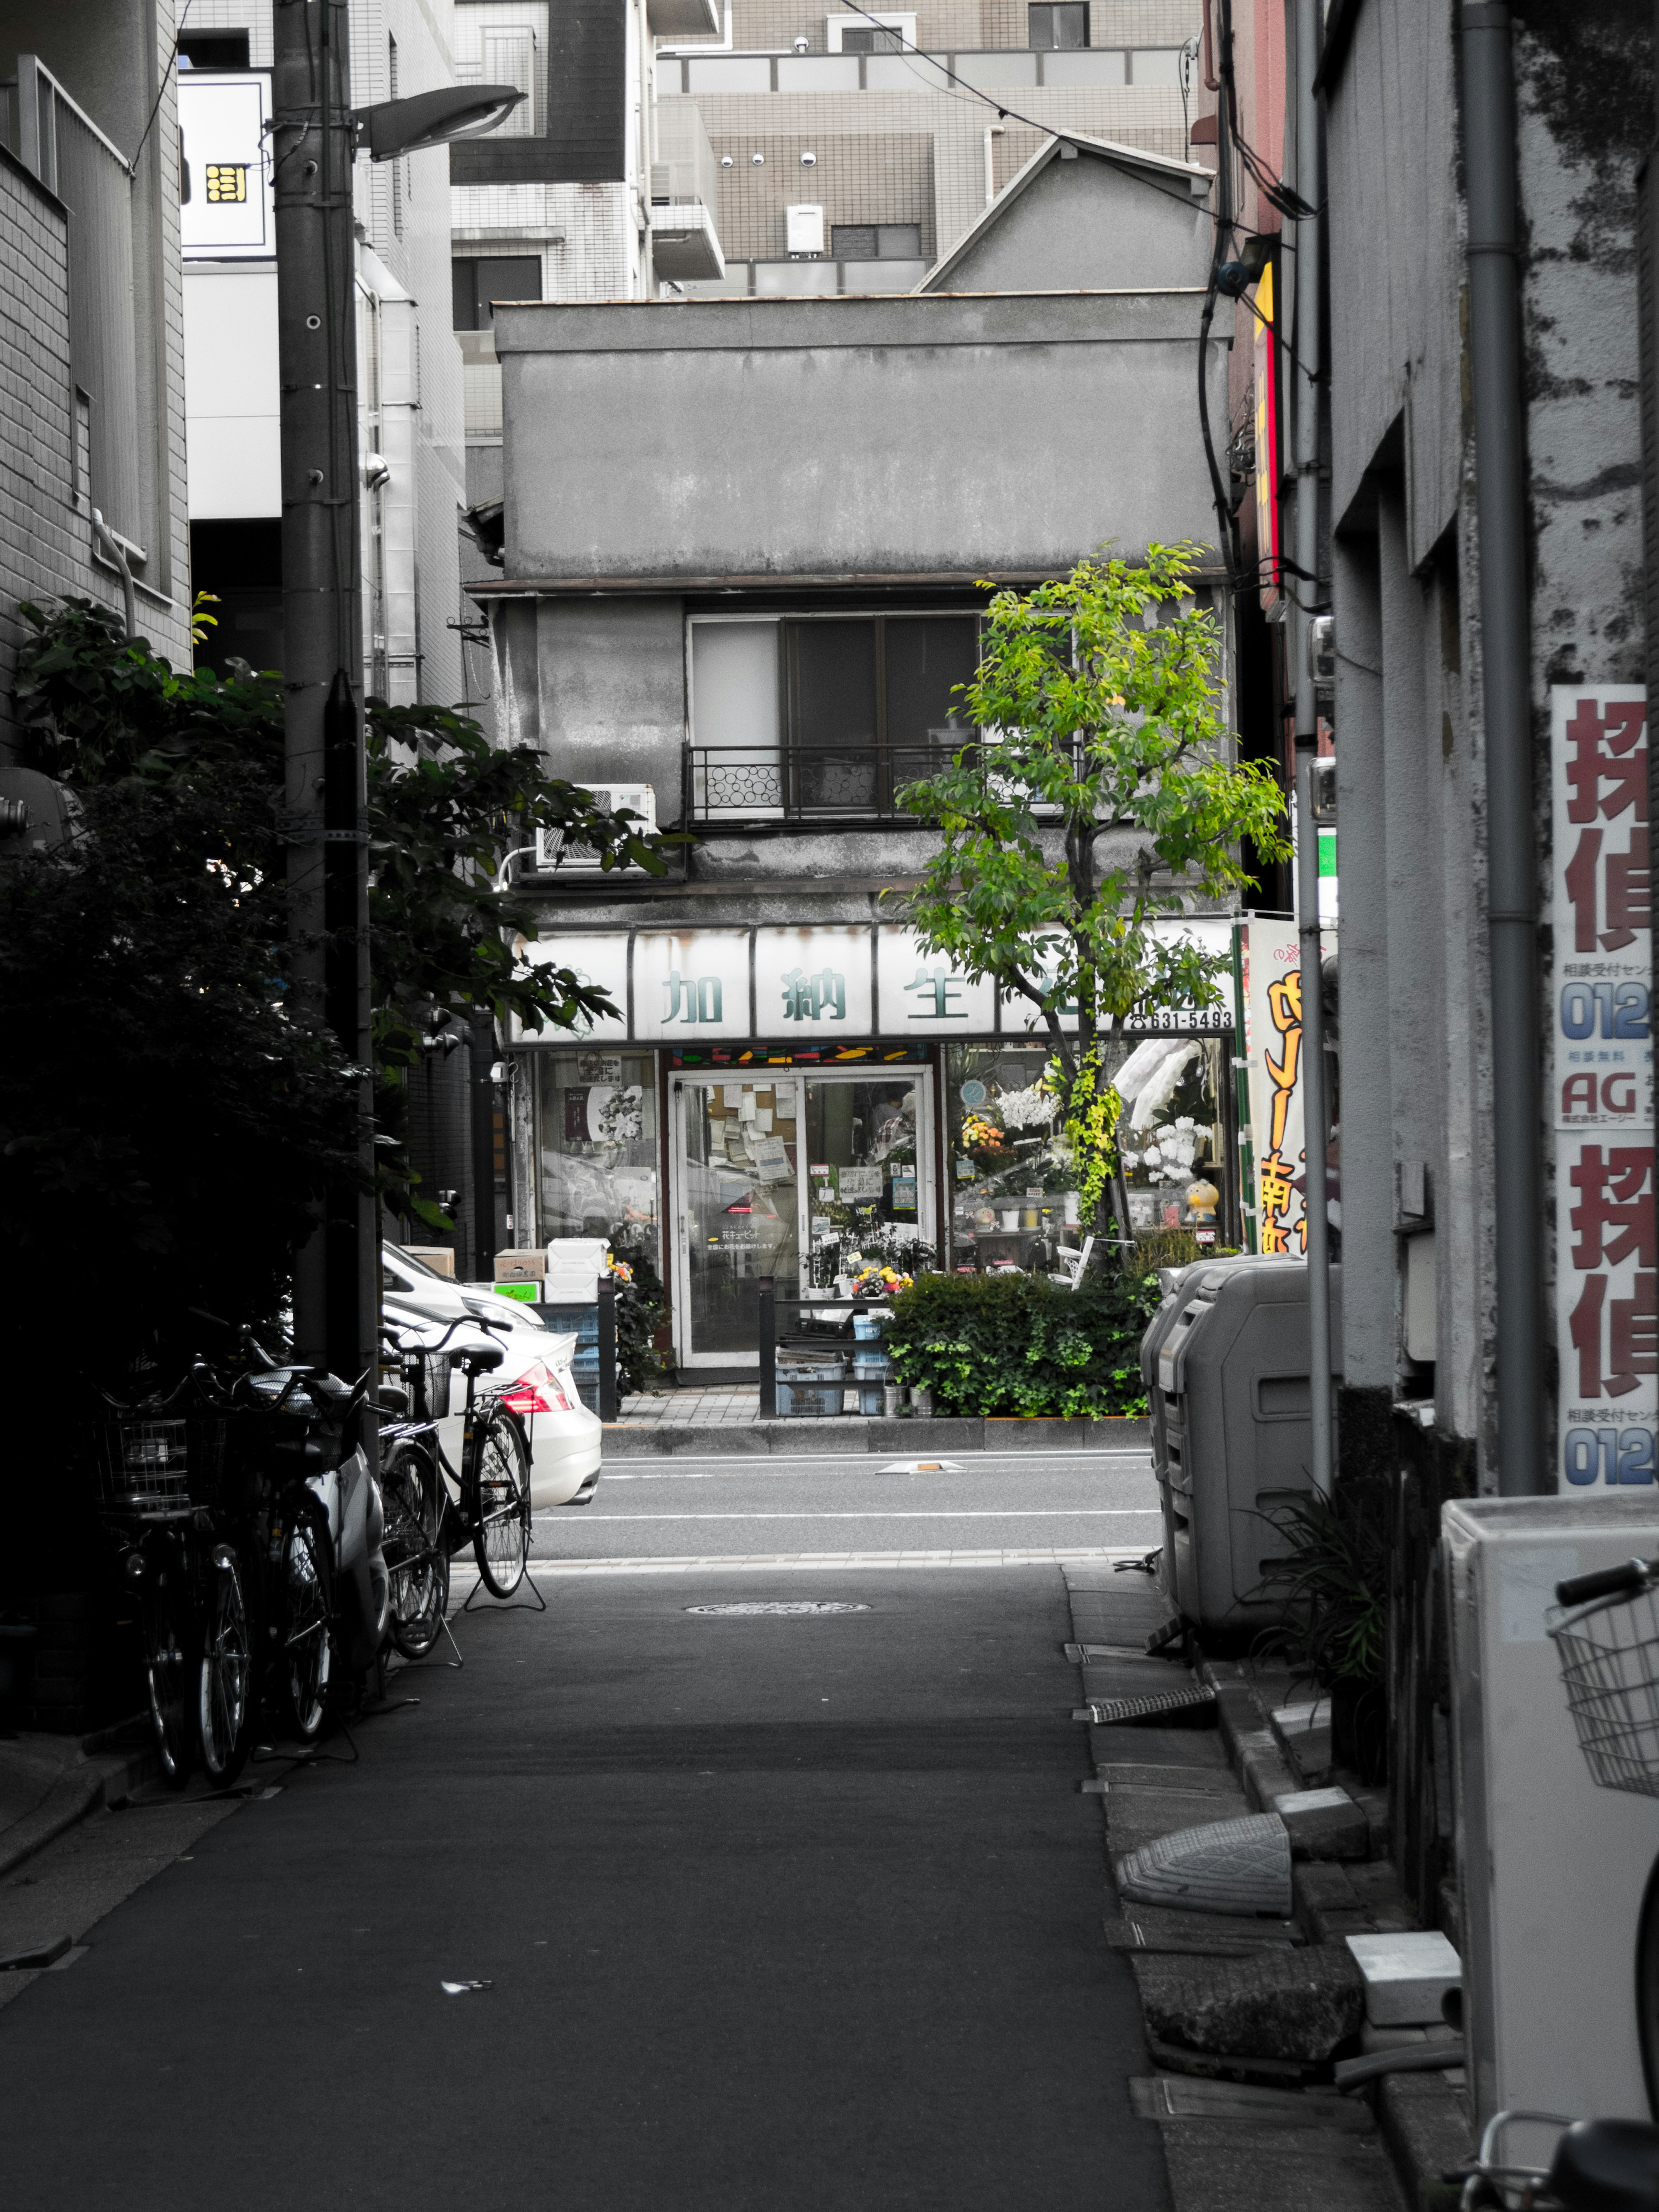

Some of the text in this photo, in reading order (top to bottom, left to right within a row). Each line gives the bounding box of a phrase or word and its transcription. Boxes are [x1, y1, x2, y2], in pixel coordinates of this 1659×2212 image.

[1151, 1011, 1232, 1029] 631-5493
[1562, 1072, 1636, 1113] AG
[722, 1230, 760, 1239] 花キューピット
